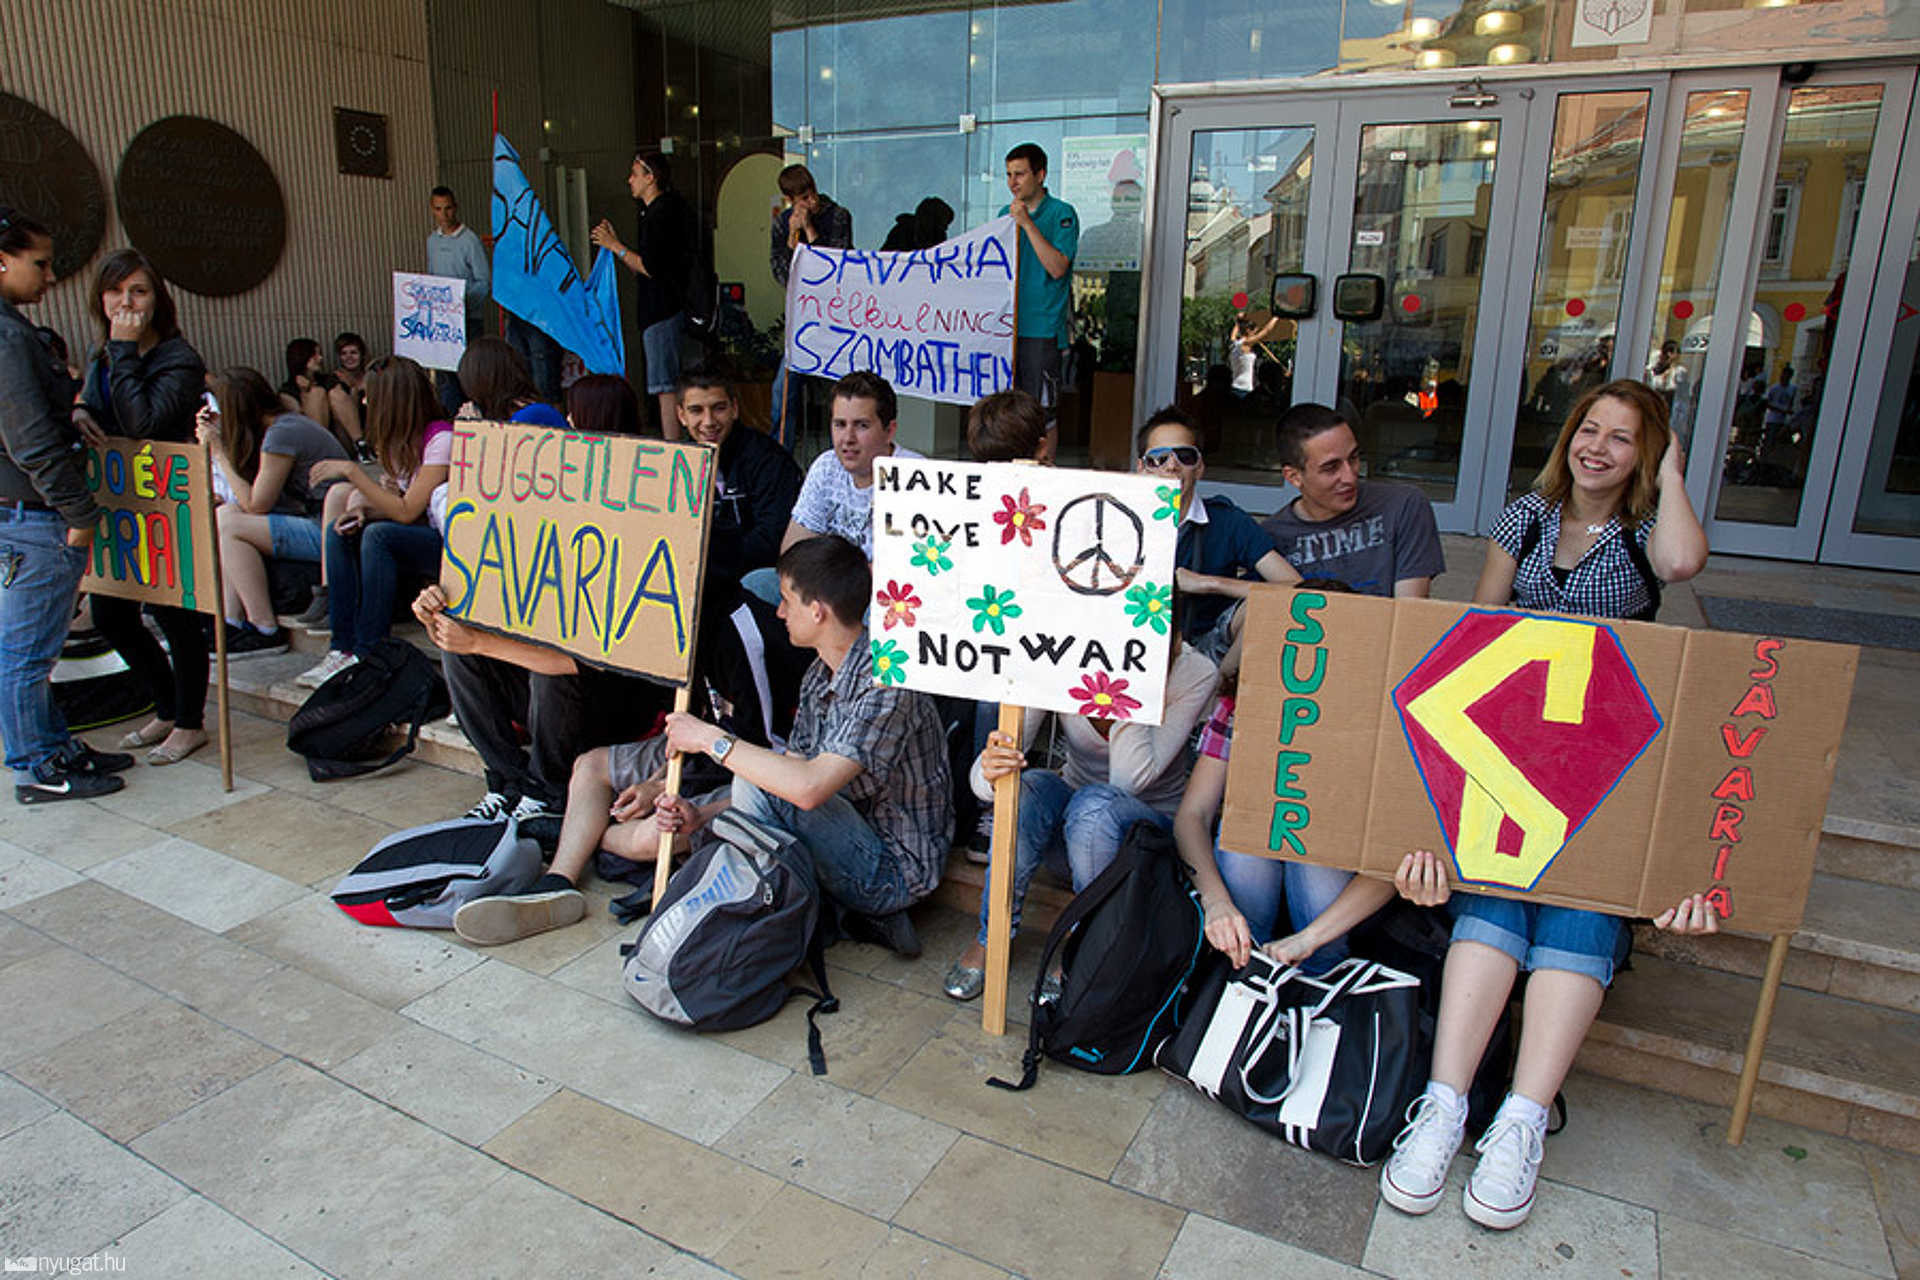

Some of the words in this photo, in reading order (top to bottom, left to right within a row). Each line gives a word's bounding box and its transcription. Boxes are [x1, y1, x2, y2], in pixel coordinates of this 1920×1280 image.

[801, 236, 1012, 285] SAVARIA
[133, 443, 190, 500] ÉVE
[878, 466, 982, 500] MAKE
[86, 503, 197, 610] ARIA!
[885, 512, 979, 547] LOVE
[443, 497, 689, 657] SAVARIA
[918, 630, 1011, 675] NOT
[1019, 633, 1146, 673] WAR
[1268, 592, 1329, 856] SUPER
[1704, 637, 1786, 919] SAVARIA
